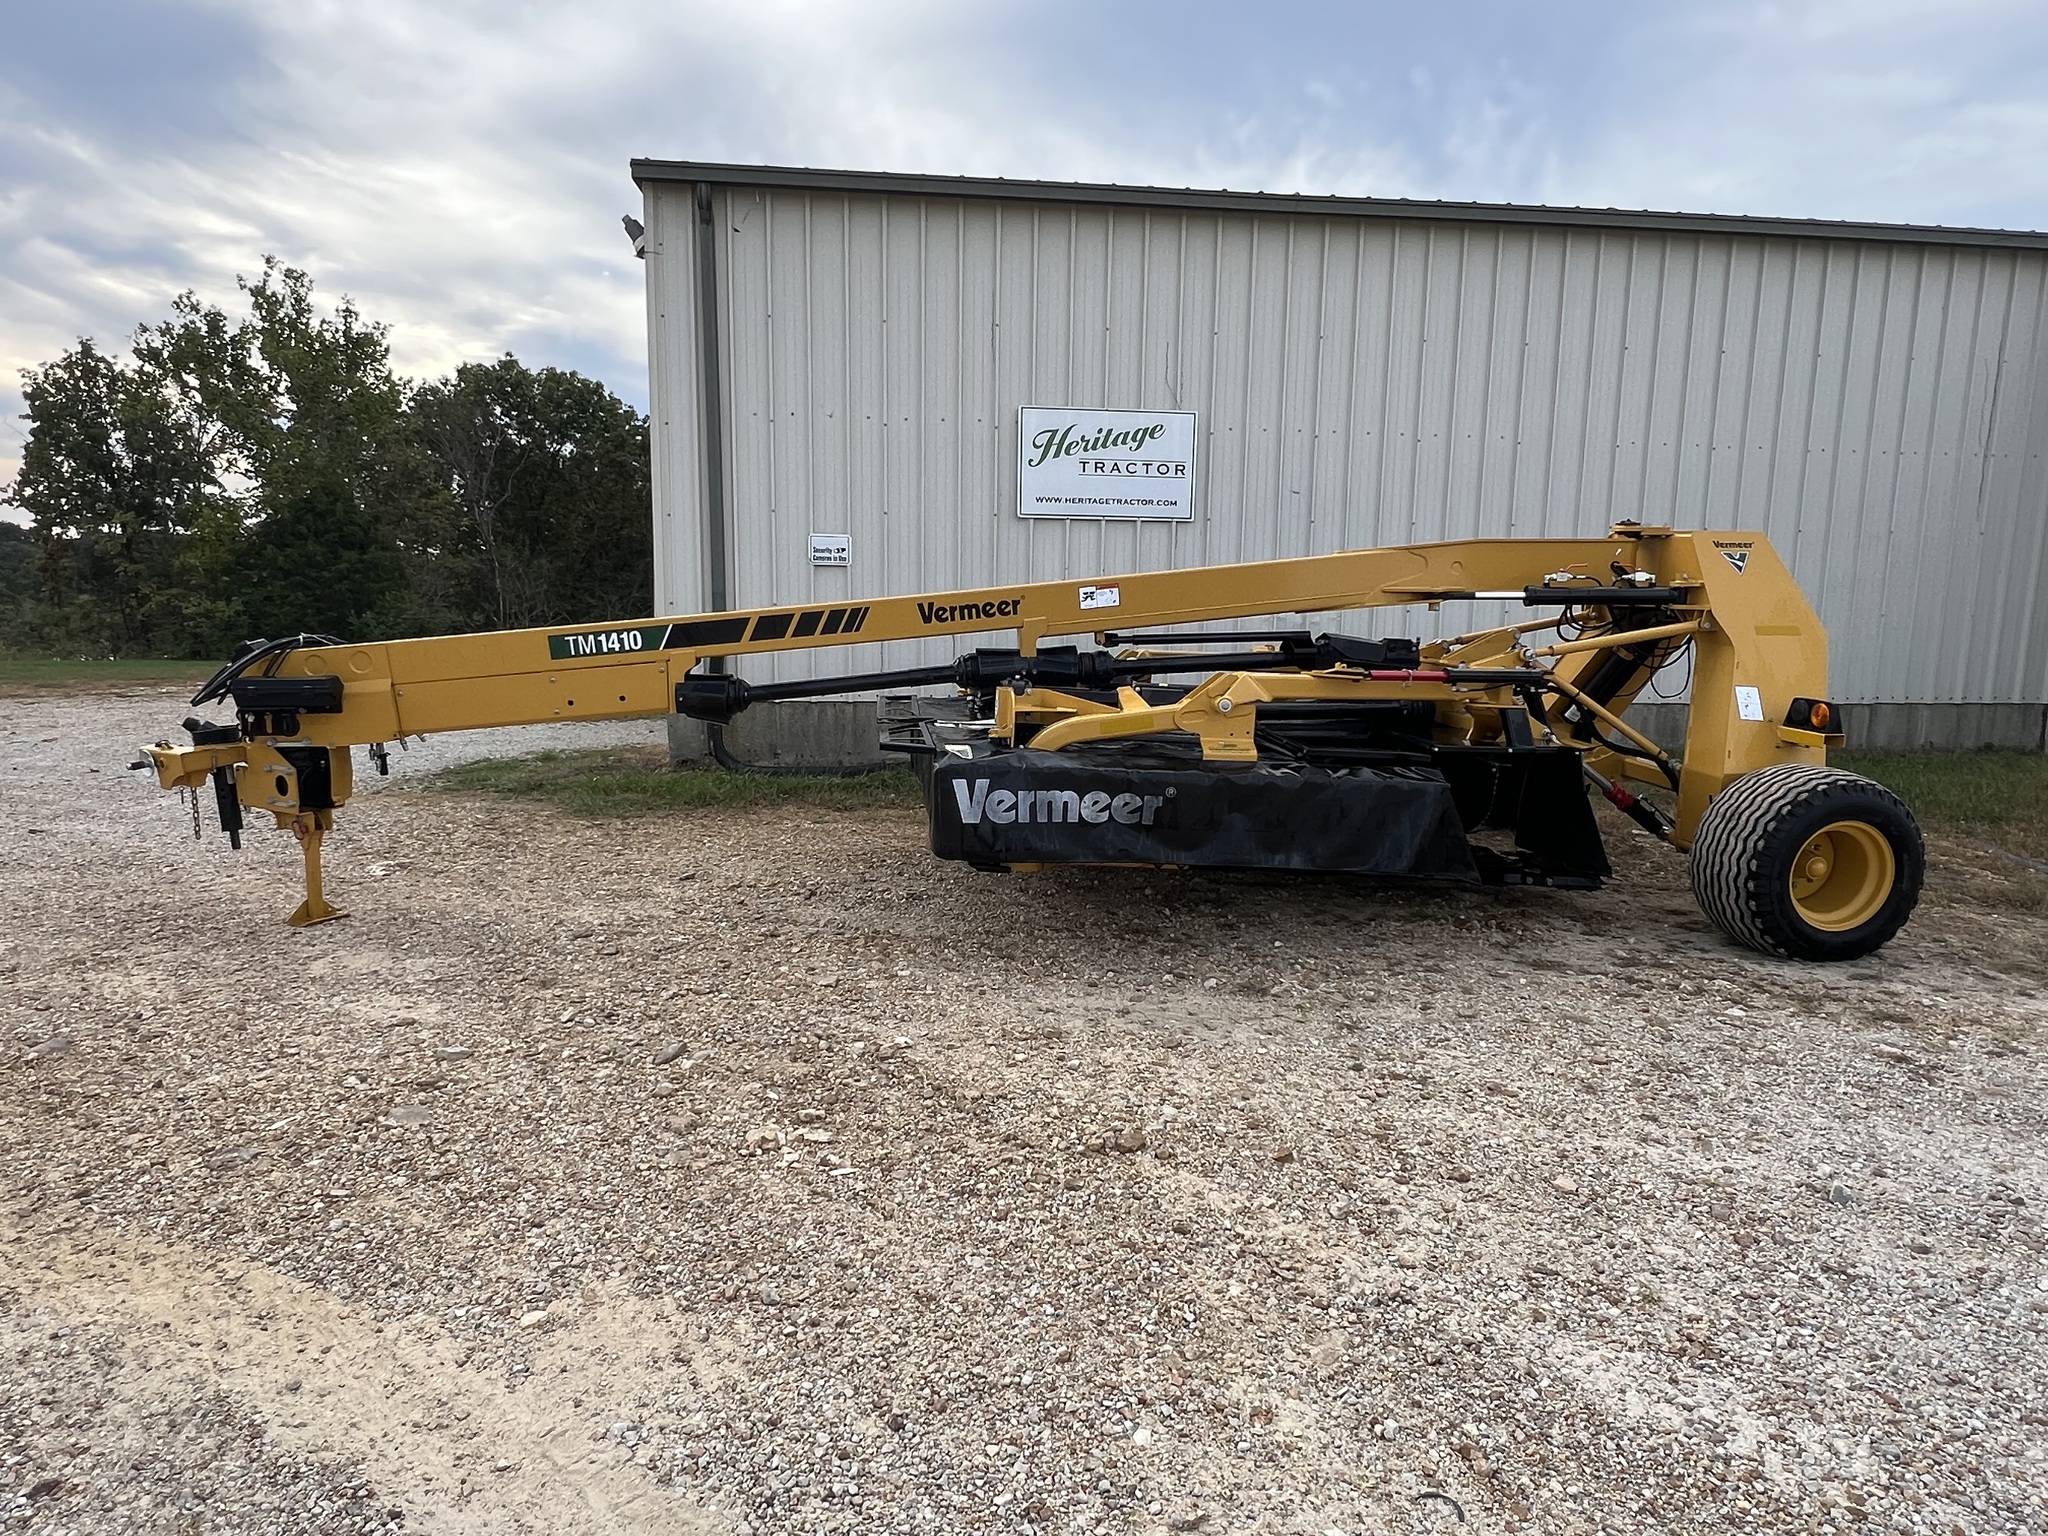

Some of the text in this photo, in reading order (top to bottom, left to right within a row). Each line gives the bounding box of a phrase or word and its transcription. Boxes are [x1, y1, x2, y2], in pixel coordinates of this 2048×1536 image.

[1028, 424, 1166, 467] Heritage
[1079, 461, 1186, 475] TRACTOR
[1035, 496, 1177, 507] WWW.HERITAGETRACTOR.COM
[1712, 540, 1754, 549] Vermeer
[917, 599, 1021, 624] Vermeer
